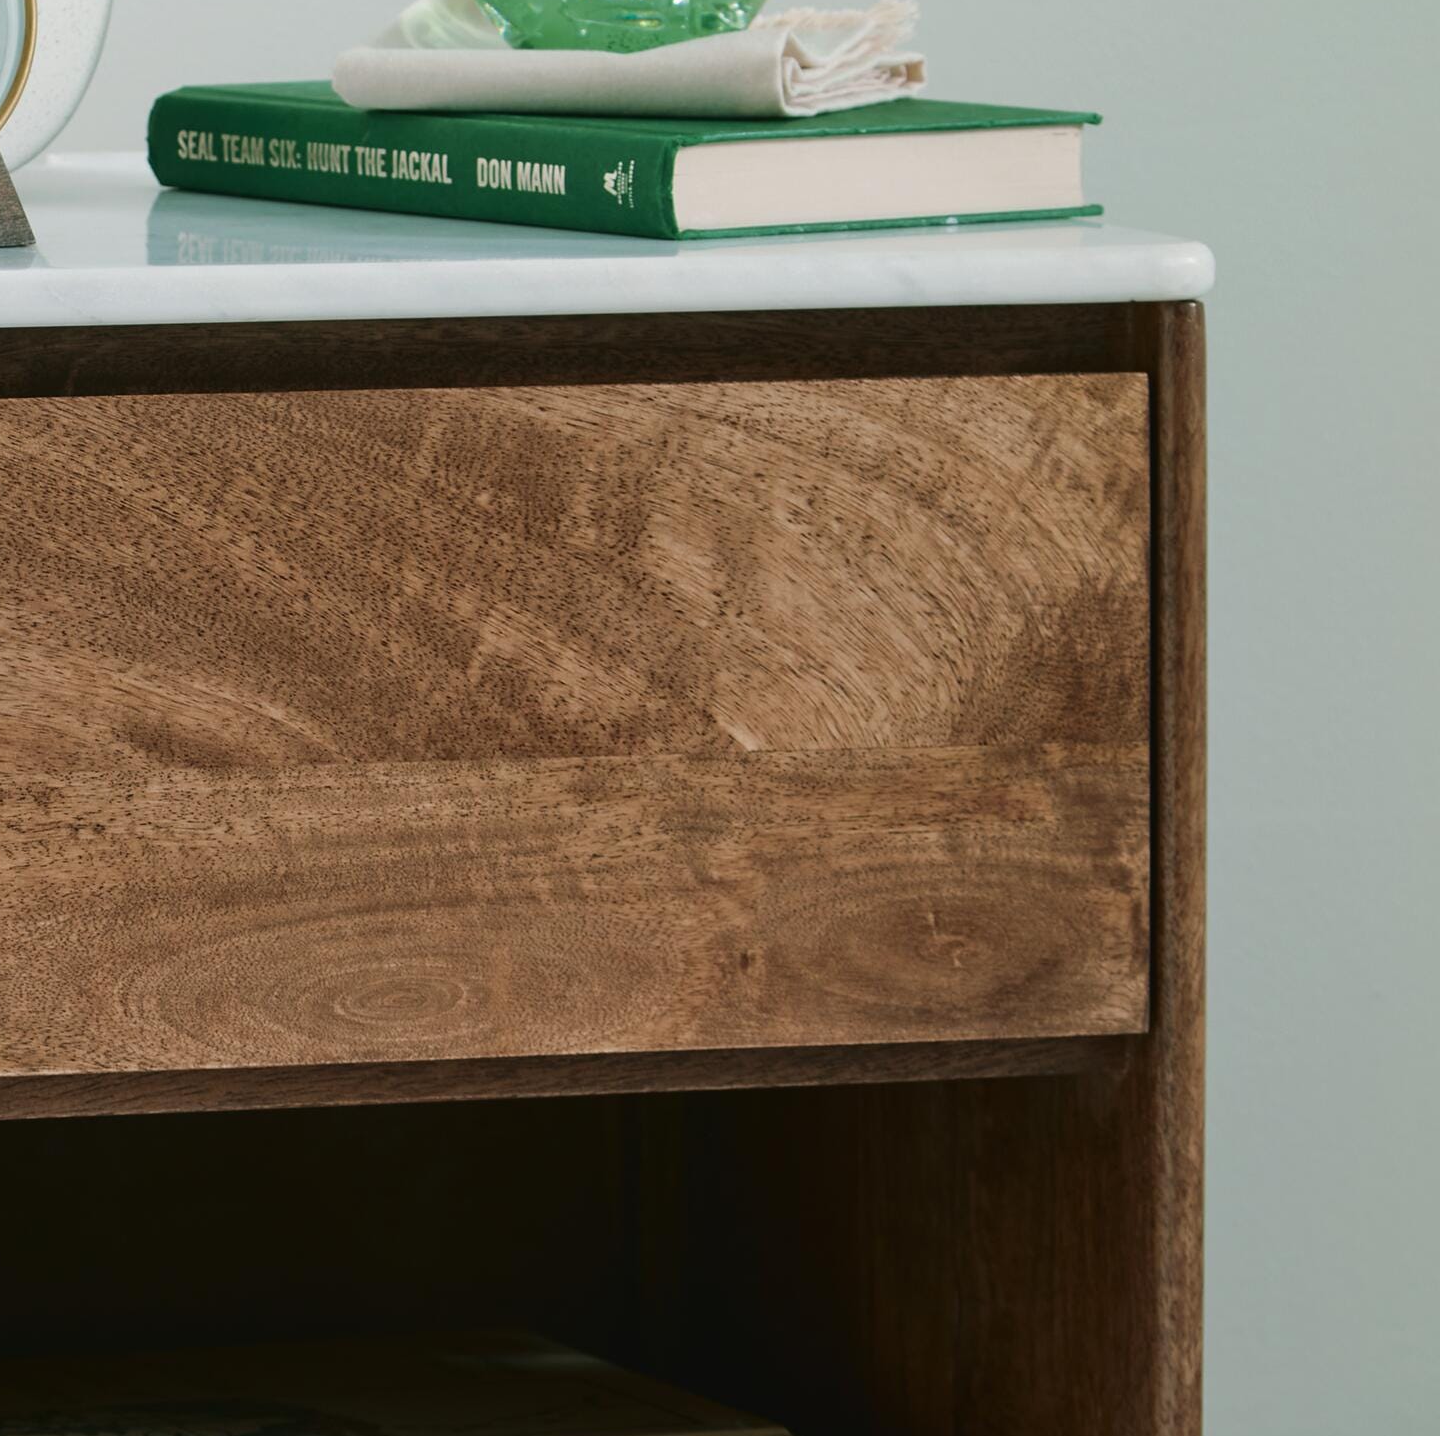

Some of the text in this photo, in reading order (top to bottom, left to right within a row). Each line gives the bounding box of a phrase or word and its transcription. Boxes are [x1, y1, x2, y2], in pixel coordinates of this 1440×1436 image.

[177, 129, 453, 184] SEAL TEAM SIX: HUNT THE JACKAL
[476, 157, 566, 195] DON MANN
